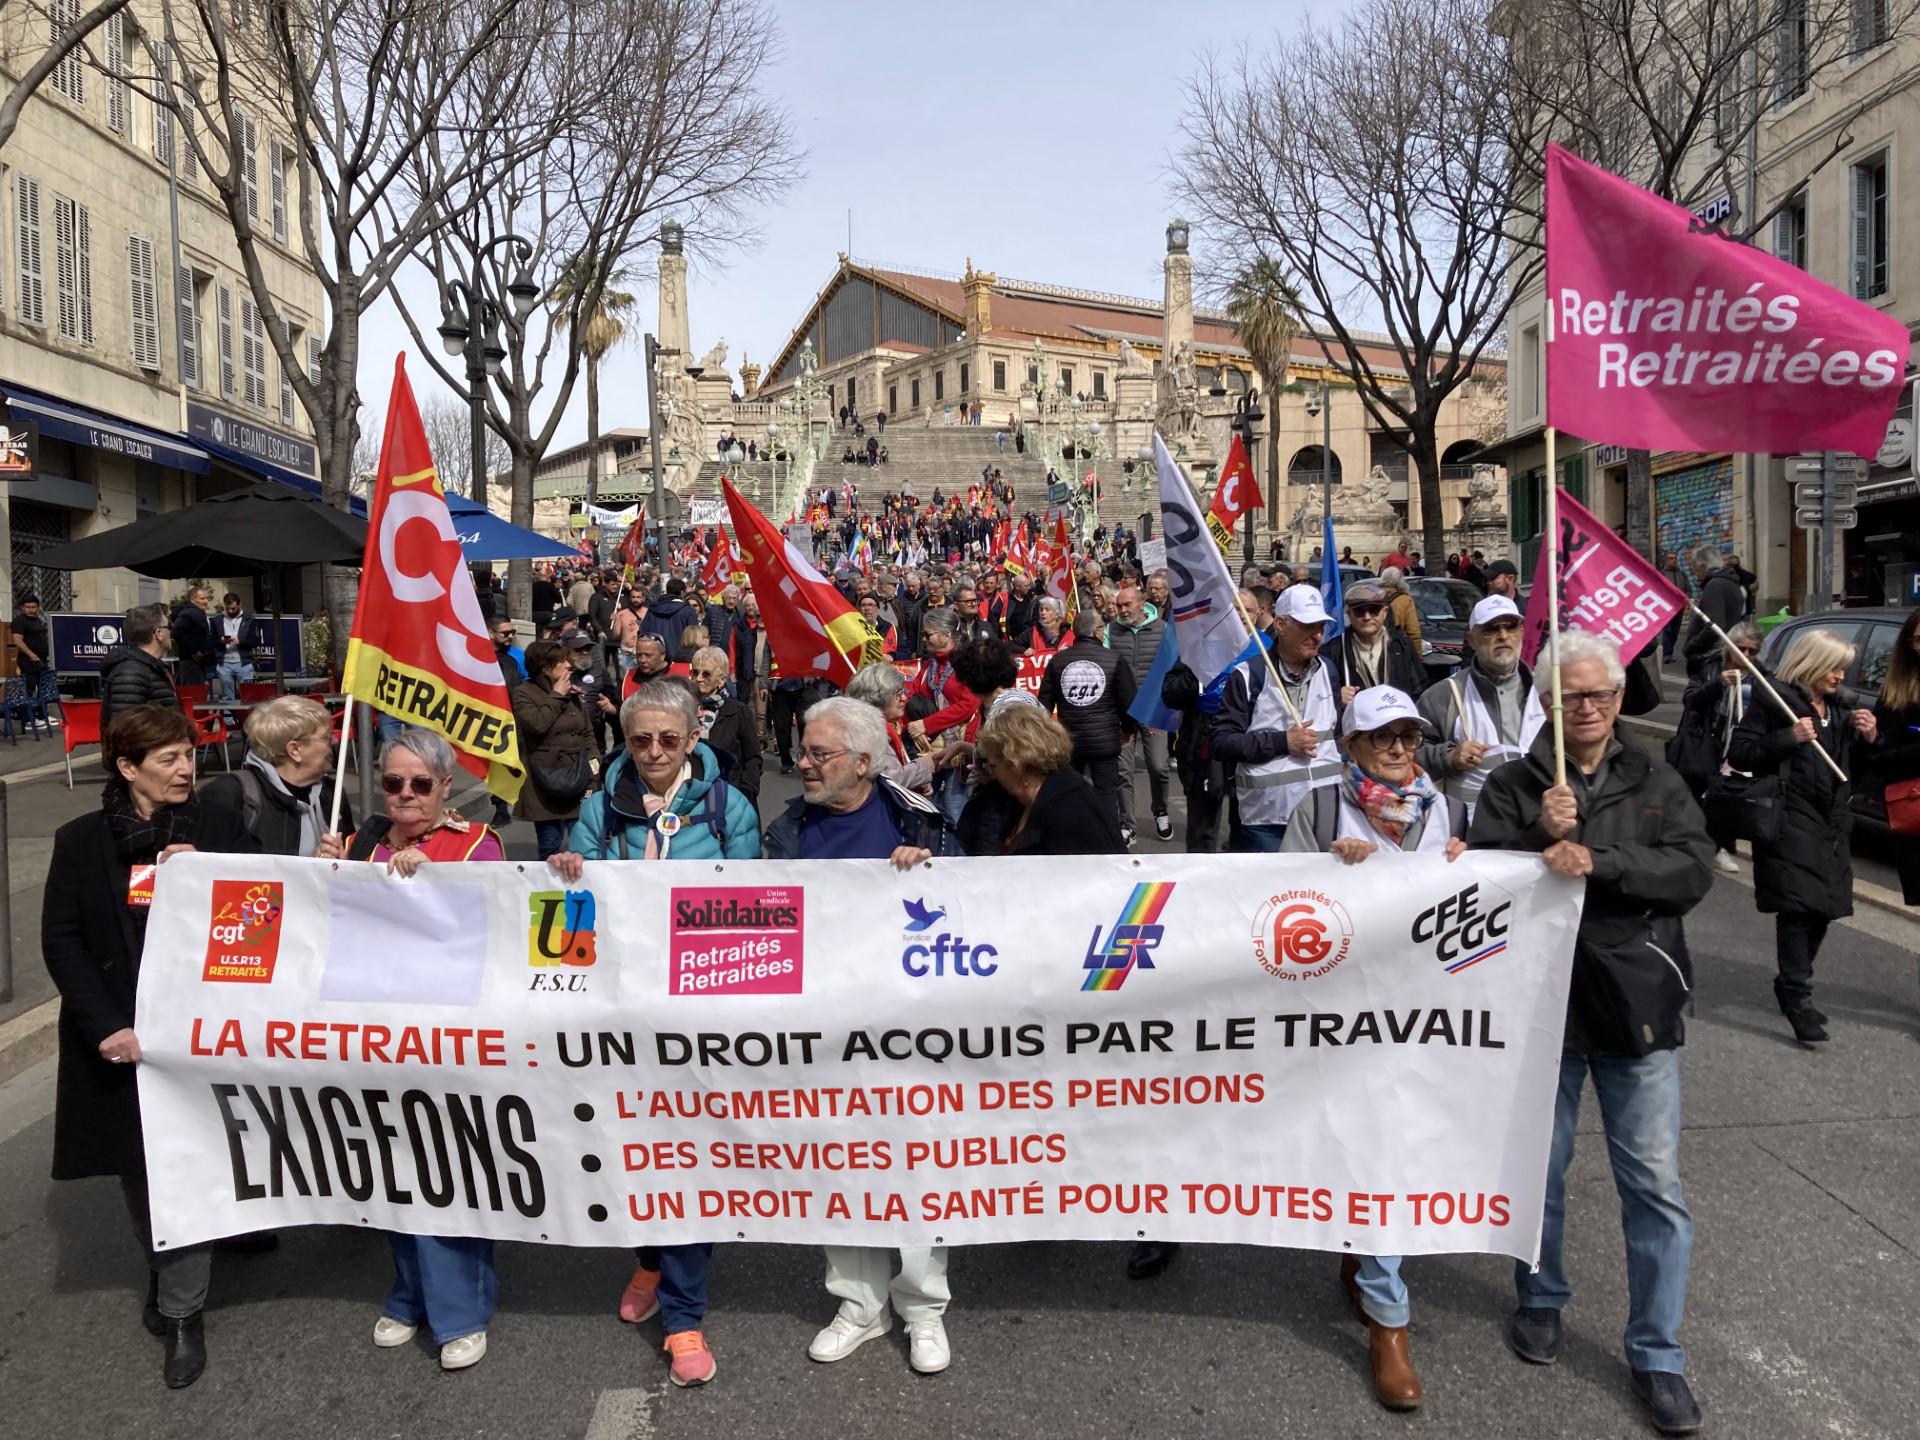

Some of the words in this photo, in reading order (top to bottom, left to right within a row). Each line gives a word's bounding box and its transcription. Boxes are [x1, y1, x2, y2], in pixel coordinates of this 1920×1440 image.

[1561, 282, 1800, 336] Retraités
[1598, 338, 1898, 388] Retraitées
[90, 429, 99, 446] LE
[101, 433, 124, 452] GRAND
[126, 440, 152, 460] ESCALIER
[228, 422, 239, 448] LE
[240, 426, 267, 456] GRAND
[268, 436, 300, 467] ESCALIER
[73, 644, 82, 655] LE
[84, 644, 108, 655] GRAND
[374, 663, 515, 755] RETRAITES
[676, 899, 798, 928] Solidaires
[1270, 888, 1332, 907] Retraités
[1411, 881, 1479, 943] CFE
[212, 921, 246, 945] cgt
[1436, 900, 1511, 962] CGC
[208, 965, 268, 978] RETRAITÉS
[679, 958, 794, 993] Retraitées
[680, 937, 781, 971] Retraités
[902, 933, 998, 978] cftc
[1252, 938, 1298, 982] Fonction
[1302, 937, 1351, 981] Publique
[528, 973, 588, 992] F.S.U.
[191, 1017, 248, 1057] LA
[266, 1021, 507, 1067] RETRAITE
[556, 1031, 636, 1068] UN
[655, 1031, 822, 1067] DROIT
[841, 1023, 1045, 1063] ACQUIS
[1066, 1020, 1174, 1054] PAR
[1195, 1017, 1256, 1051] LE
[1274, 1008, 1505, 1049] TRAVAIL
[616, 1083, 964, 1120] L'AUGMENTATION
[979, 1080, 1054, 1111] DES
[1068, 1073, 1265, 1108] PENSIONS
[210, 1083, 546, 1219] EXIGEONS
[623, 1141, 698, 1172] DES
[710, 1141, 893, 1171] SERVICES
[905, 1133, 1067, 1170] PUBLICS
[628, 1191, 685, 1222] UN
[699, 1190, 813, 1218] DROIT
[826, 1192, 852, 1220] A
[864, 1192, 909, 1222] LA
[922, 1181, 1044, 1221] SANTÉ
[1058, 1184, 1169, 1214] POUR
[1180, 1184, 1333, 1222] TOUTES
[1347, 1192, 1395, 1227] ET
[1406, 1192, 1511, 1227] TOUS
